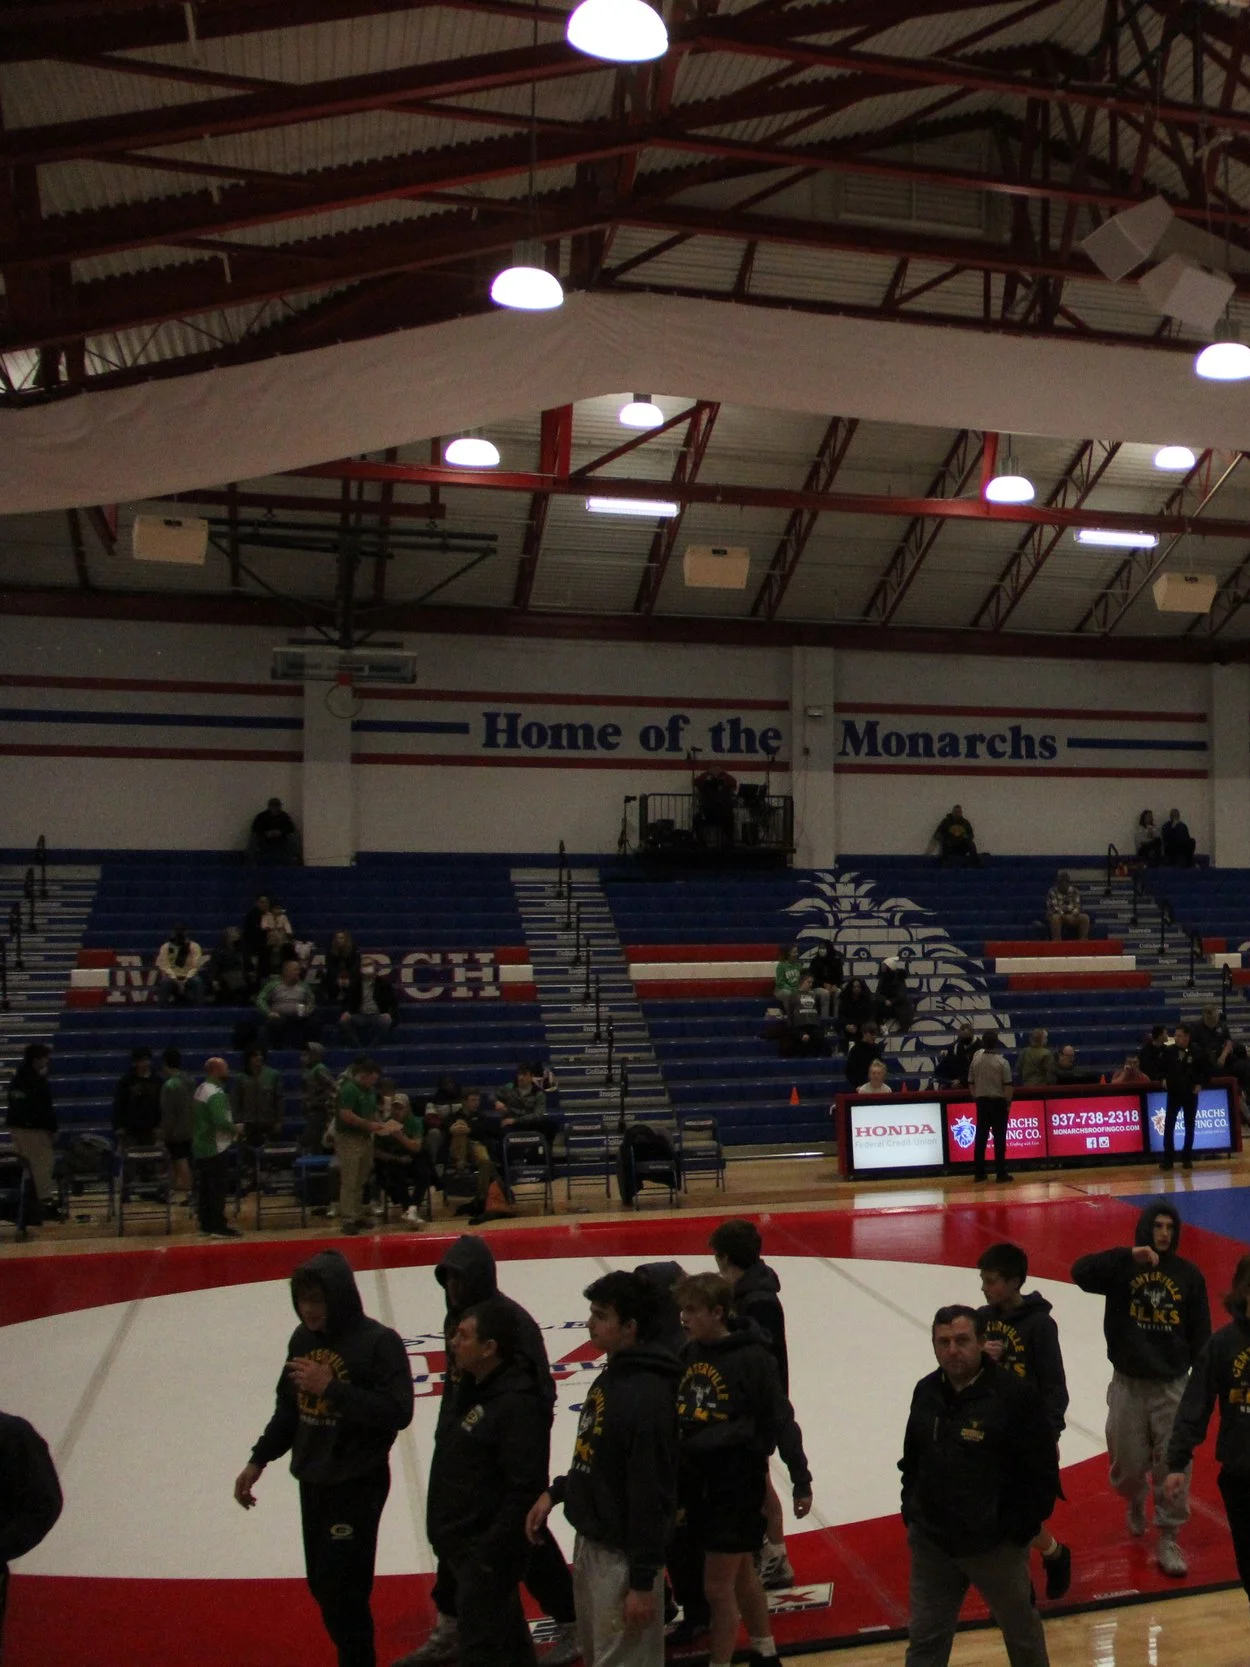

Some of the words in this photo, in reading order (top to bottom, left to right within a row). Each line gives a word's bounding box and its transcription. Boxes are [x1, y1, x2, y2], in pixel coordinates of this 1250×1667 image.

[482, 712, 622, 750] Home
[639, 714, 690, 751] of
[709, 717, 782, 753] the
[838, 720, 1058, 760] Monarchs
[570, 1005, 610, 1013] Collabrate
[1051, 1110, 1140, 1127] 937-738-2318
[1214, 1118, 1229, 1128] CO.
[855, 1124, 936, 1138] HONDA
[1025, 1128, 1042, 1140] CO.
[1053, 1124, 1141, 1136] MONARCHSROOFINGCO.COM
[855, 1140, 884, 1149] Federal
[886, 1138, 911, 1147] Credit
[914, 1137, 937, 1146] Union
